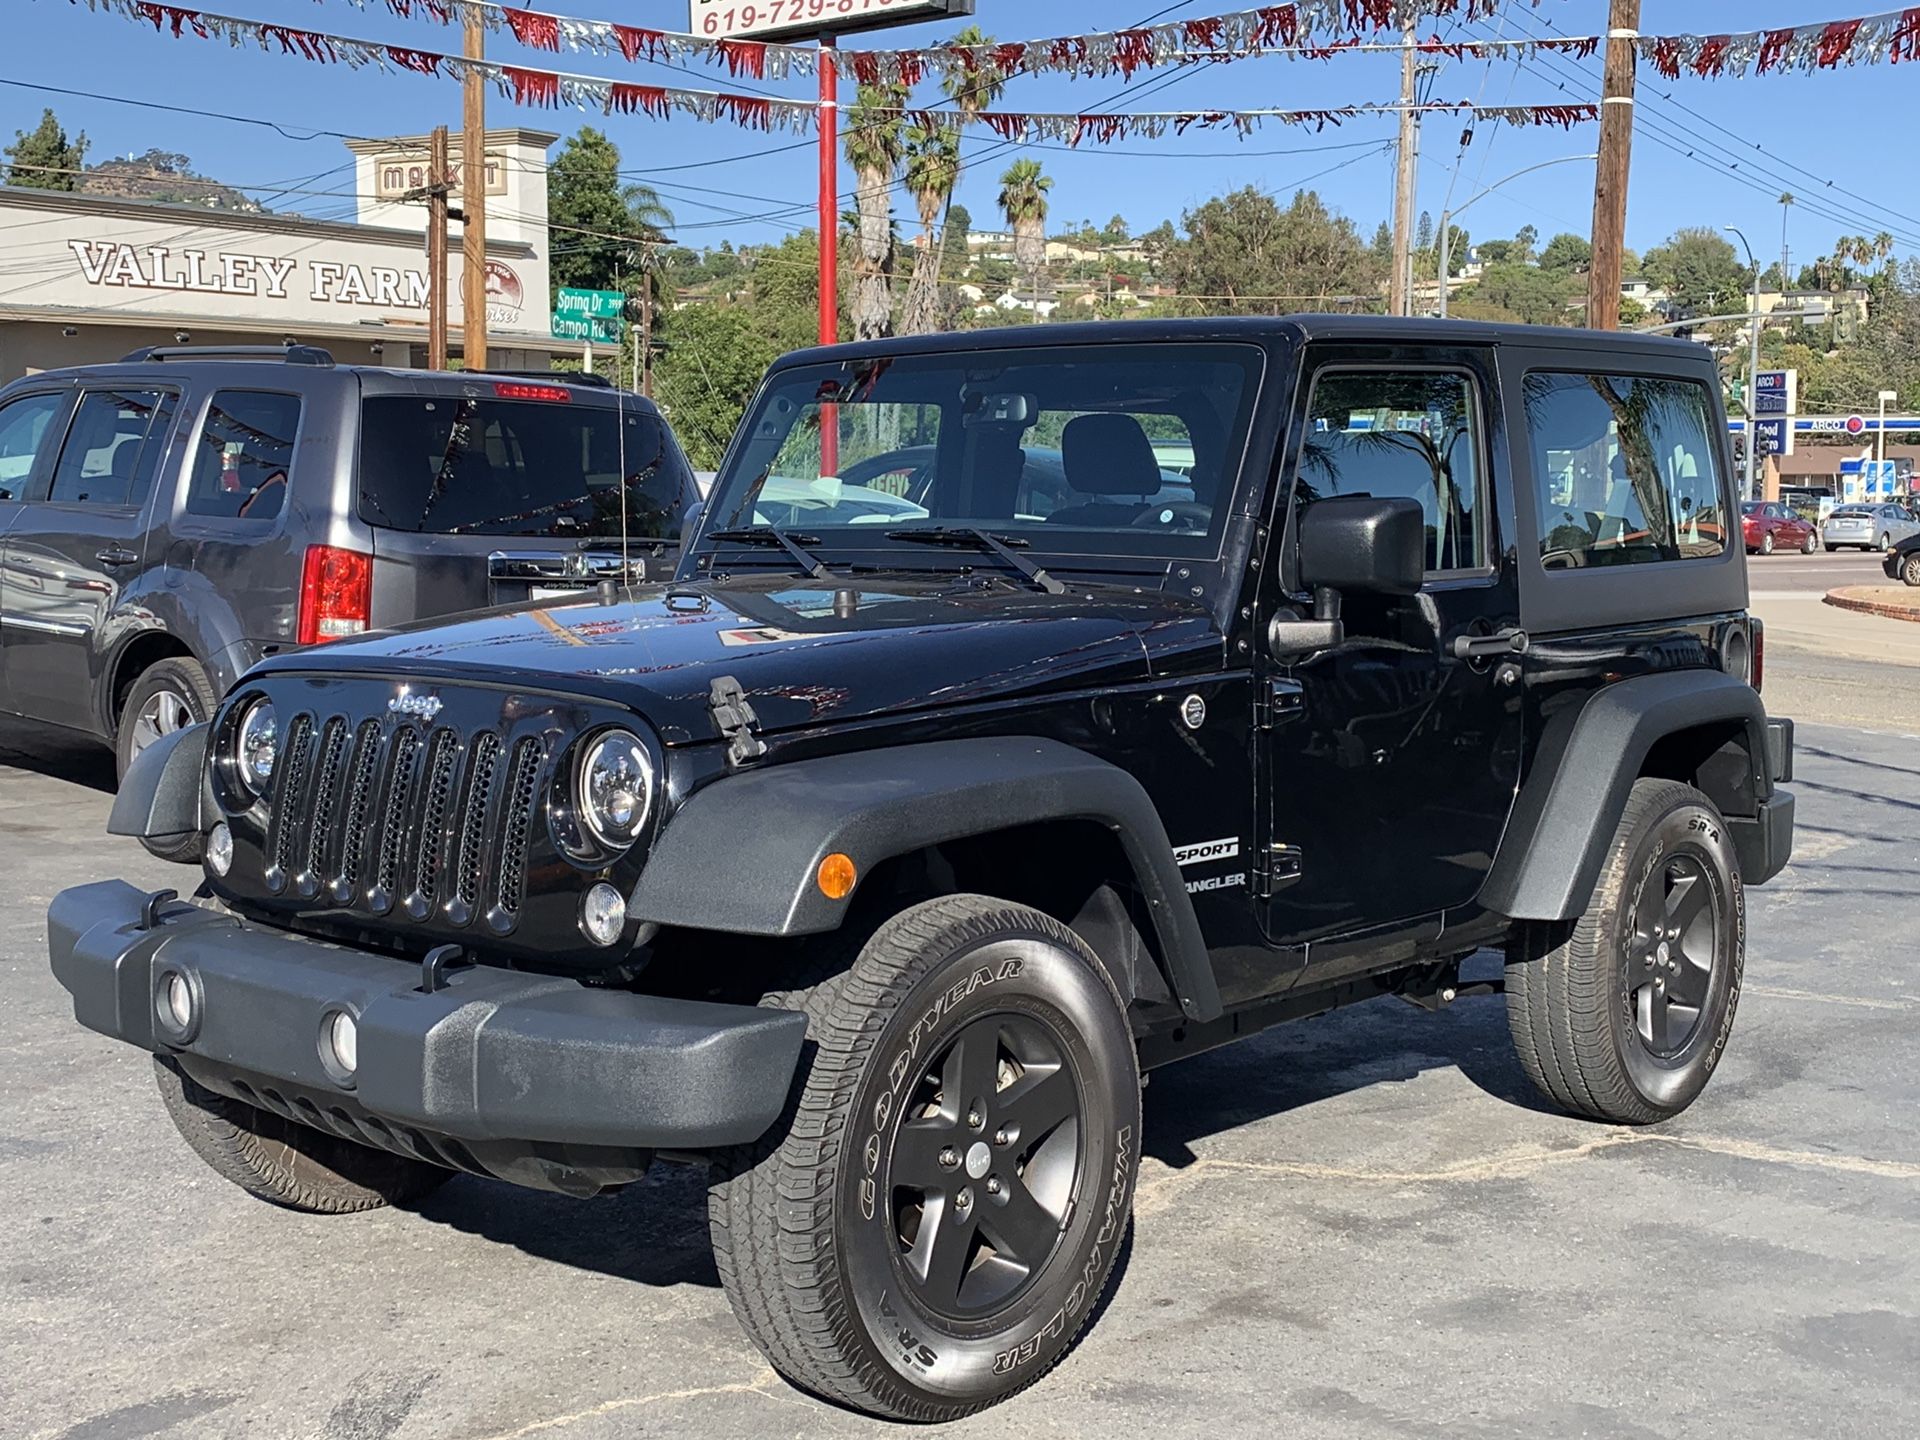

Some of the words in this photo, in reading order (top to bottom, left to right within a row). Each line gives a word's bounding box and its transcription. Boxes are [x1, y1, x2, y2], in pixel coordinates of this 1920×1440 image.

[67, 239, 296, 299] VALLEY
[558, 290, 590, 314] Spring
[592, 293, 604, 312] Dr
[552, 315, 589, 340] Campo
[591, 320, 606, 338] Rd
[1757, 376, 1774, 388] ARCO
[1811, 420, 1841, 431] ARCO
[388, 683, 440, 721] Jeep
[1175, 843, 1233, 862] SPORT
[1185, 872, 1246, 894] ANGLER
[1704, 871, 1745, 1072] GOODYEAR
[859, 957, 1024, 1221] GOODYEAR
[992, 1124, 1131, 1375] WRANGLER
